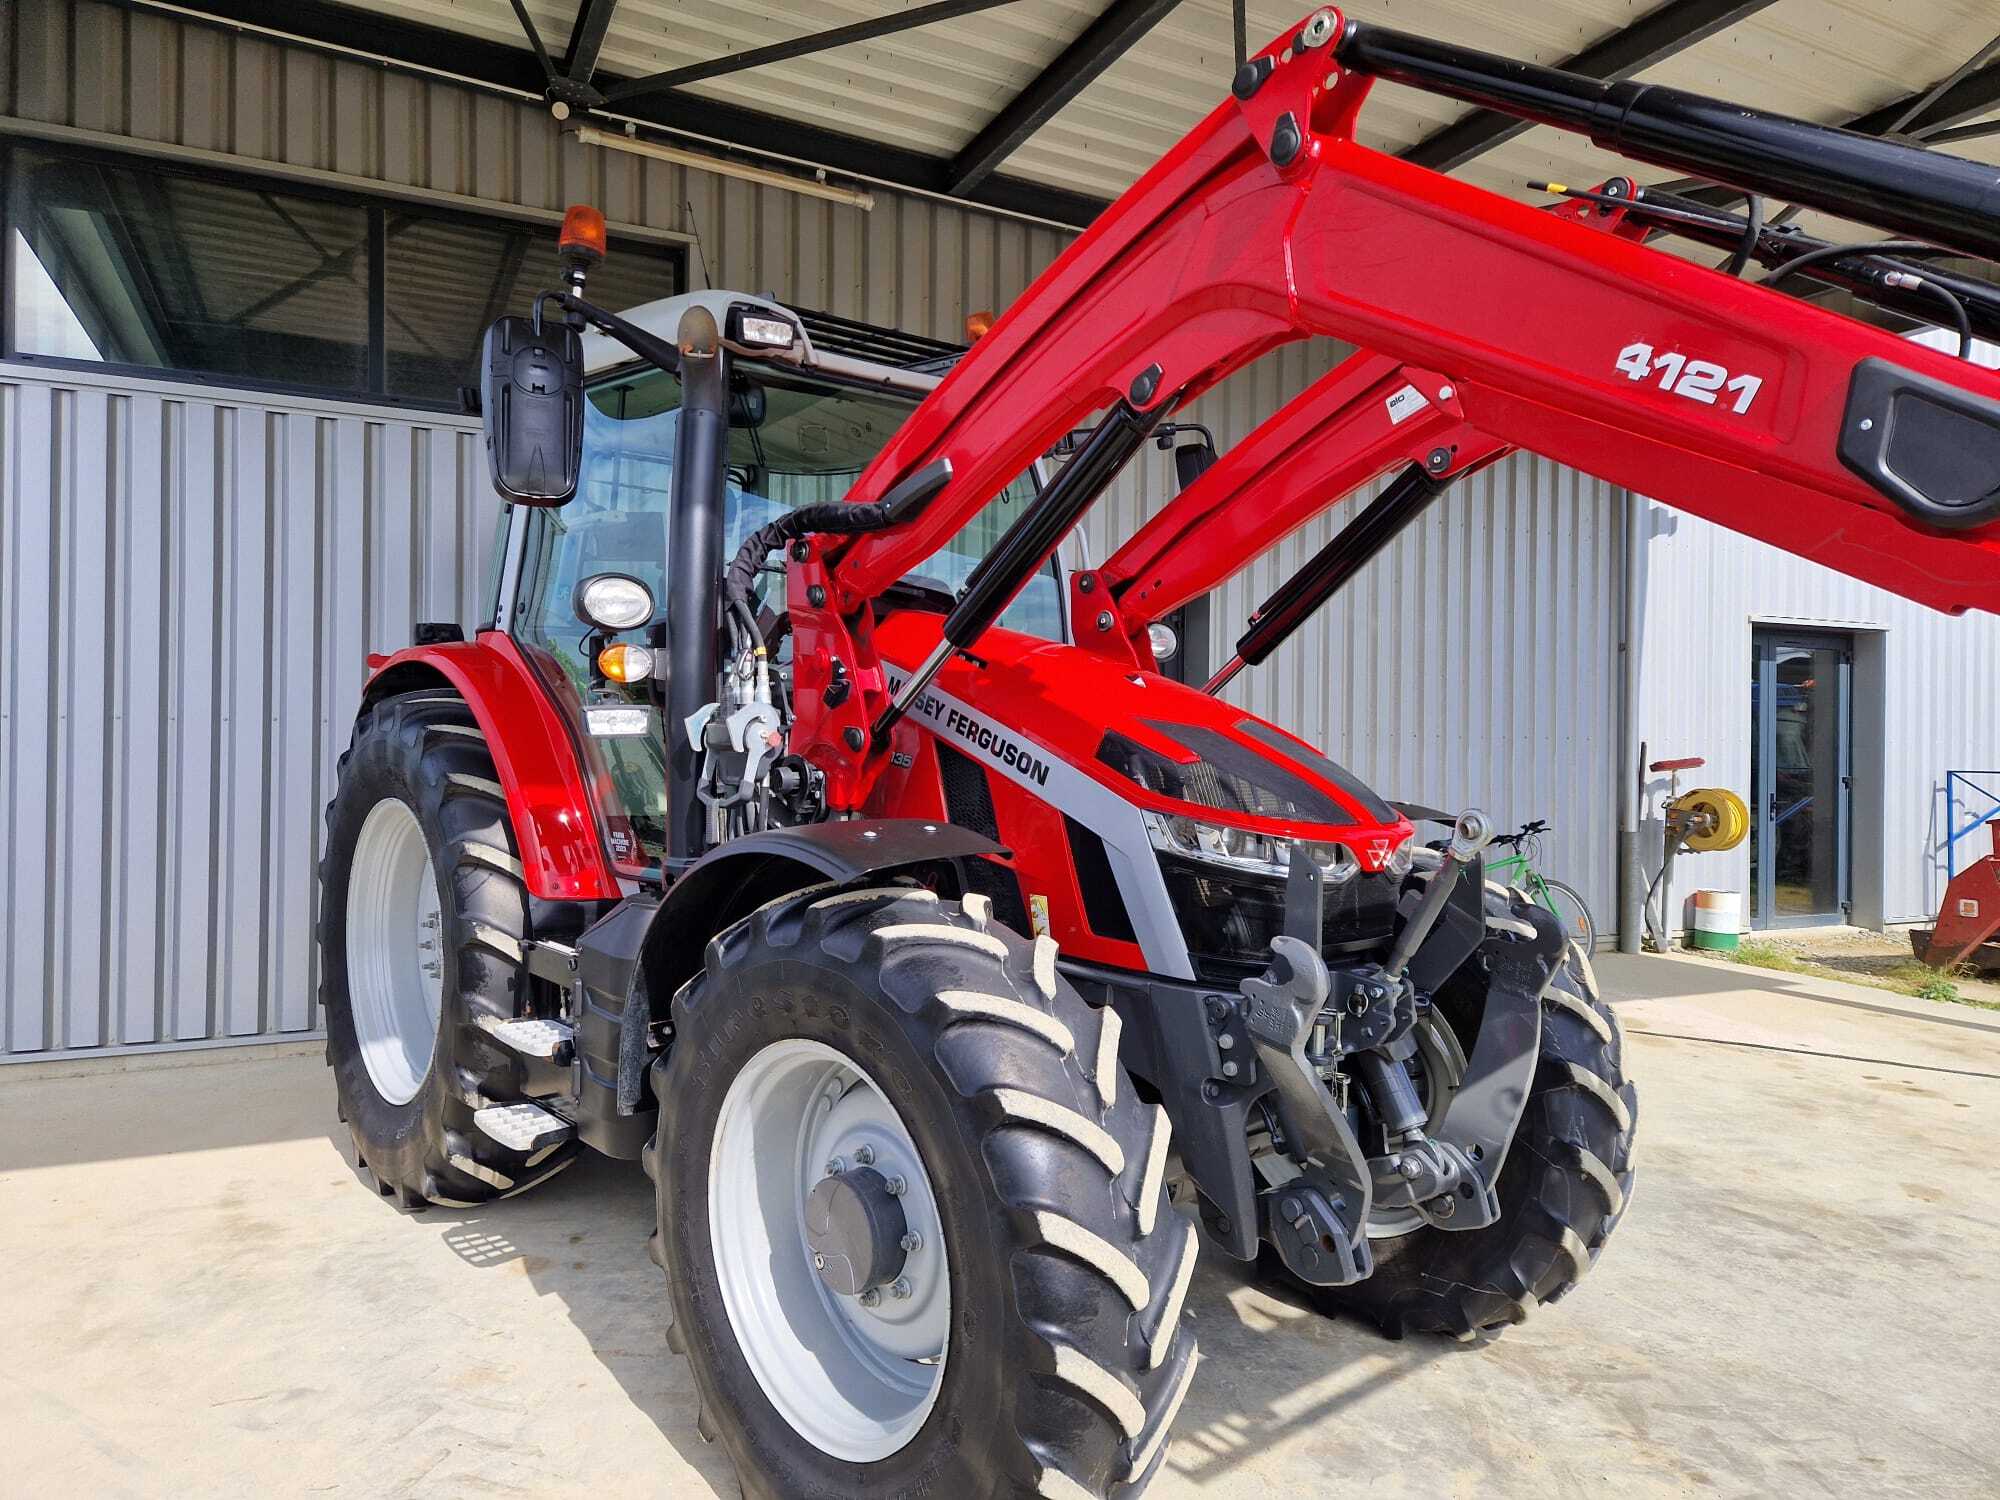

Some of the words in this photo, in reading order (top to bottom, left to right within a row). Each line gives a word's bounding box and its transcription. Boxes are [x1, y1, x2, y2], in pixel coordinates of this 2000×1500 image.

[1615, 342, 1763, 415] 4121
[888, 676, 946, 721] MSEY
[946, 708, 1050, 787] FERGUSON
